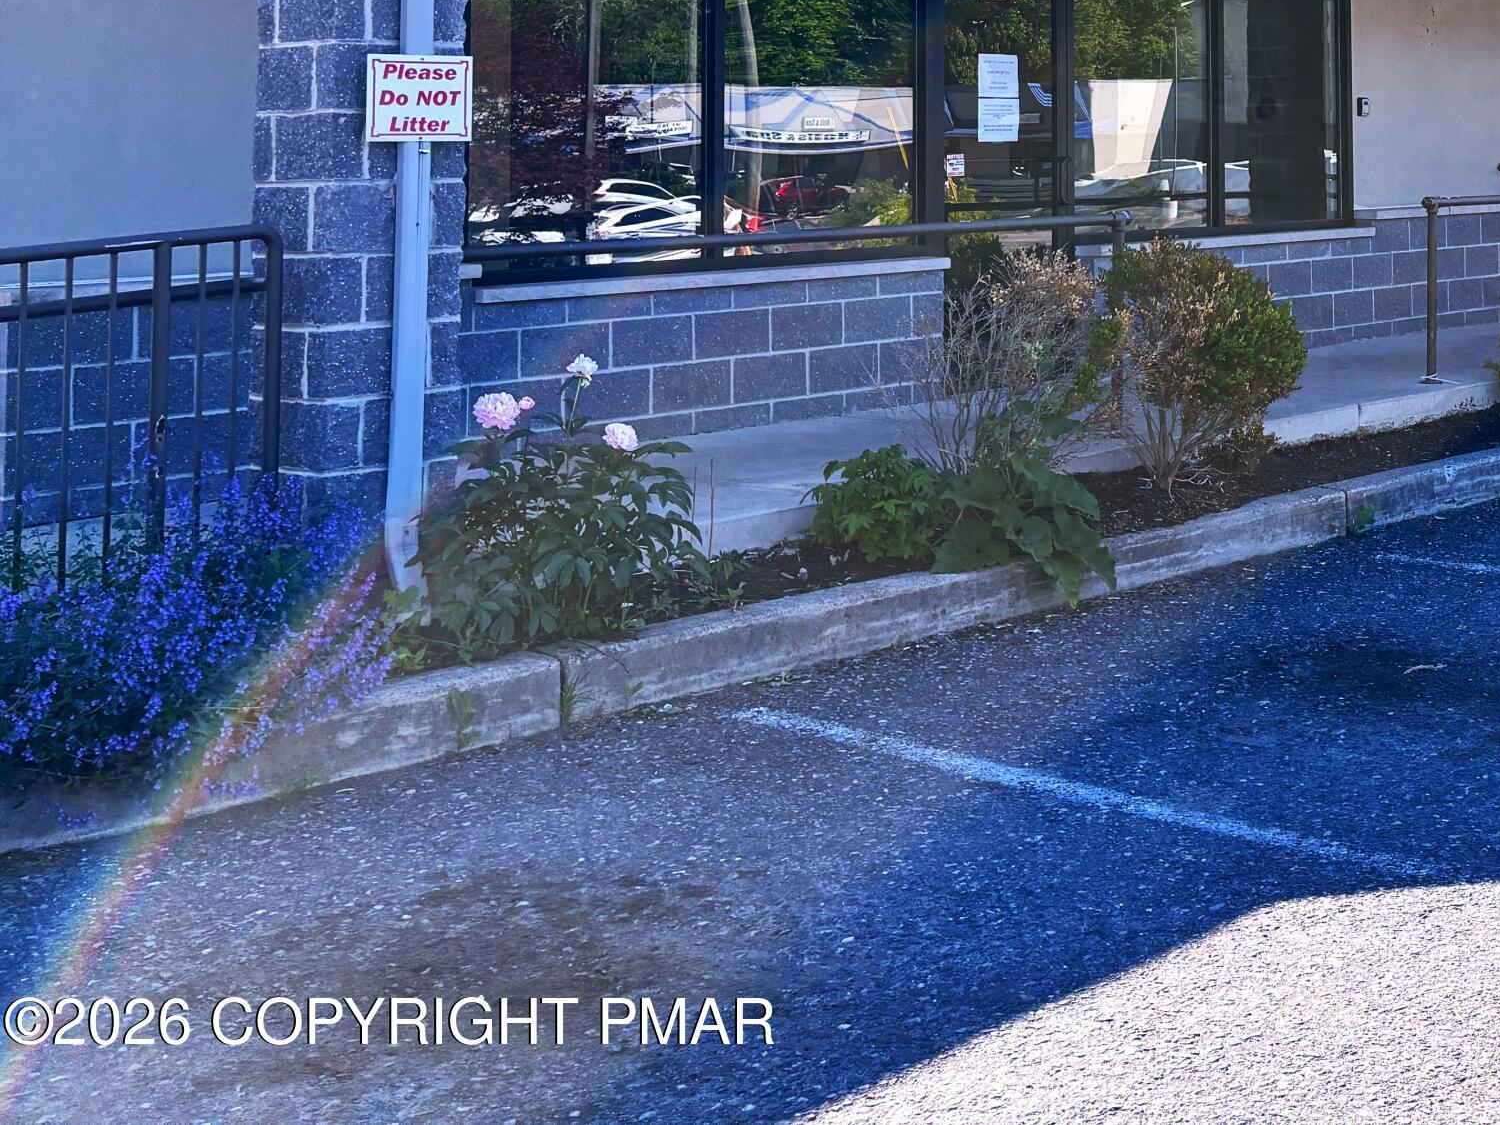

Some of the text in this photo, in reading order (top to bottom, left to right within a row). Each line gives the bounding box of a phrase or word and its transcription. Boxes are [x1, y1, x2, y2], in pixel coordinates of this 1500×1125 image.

[383, 64, 457, 80] Please
[379, 90, 461, 106] Do NOT
[389, 116, 450, 132] Litter
